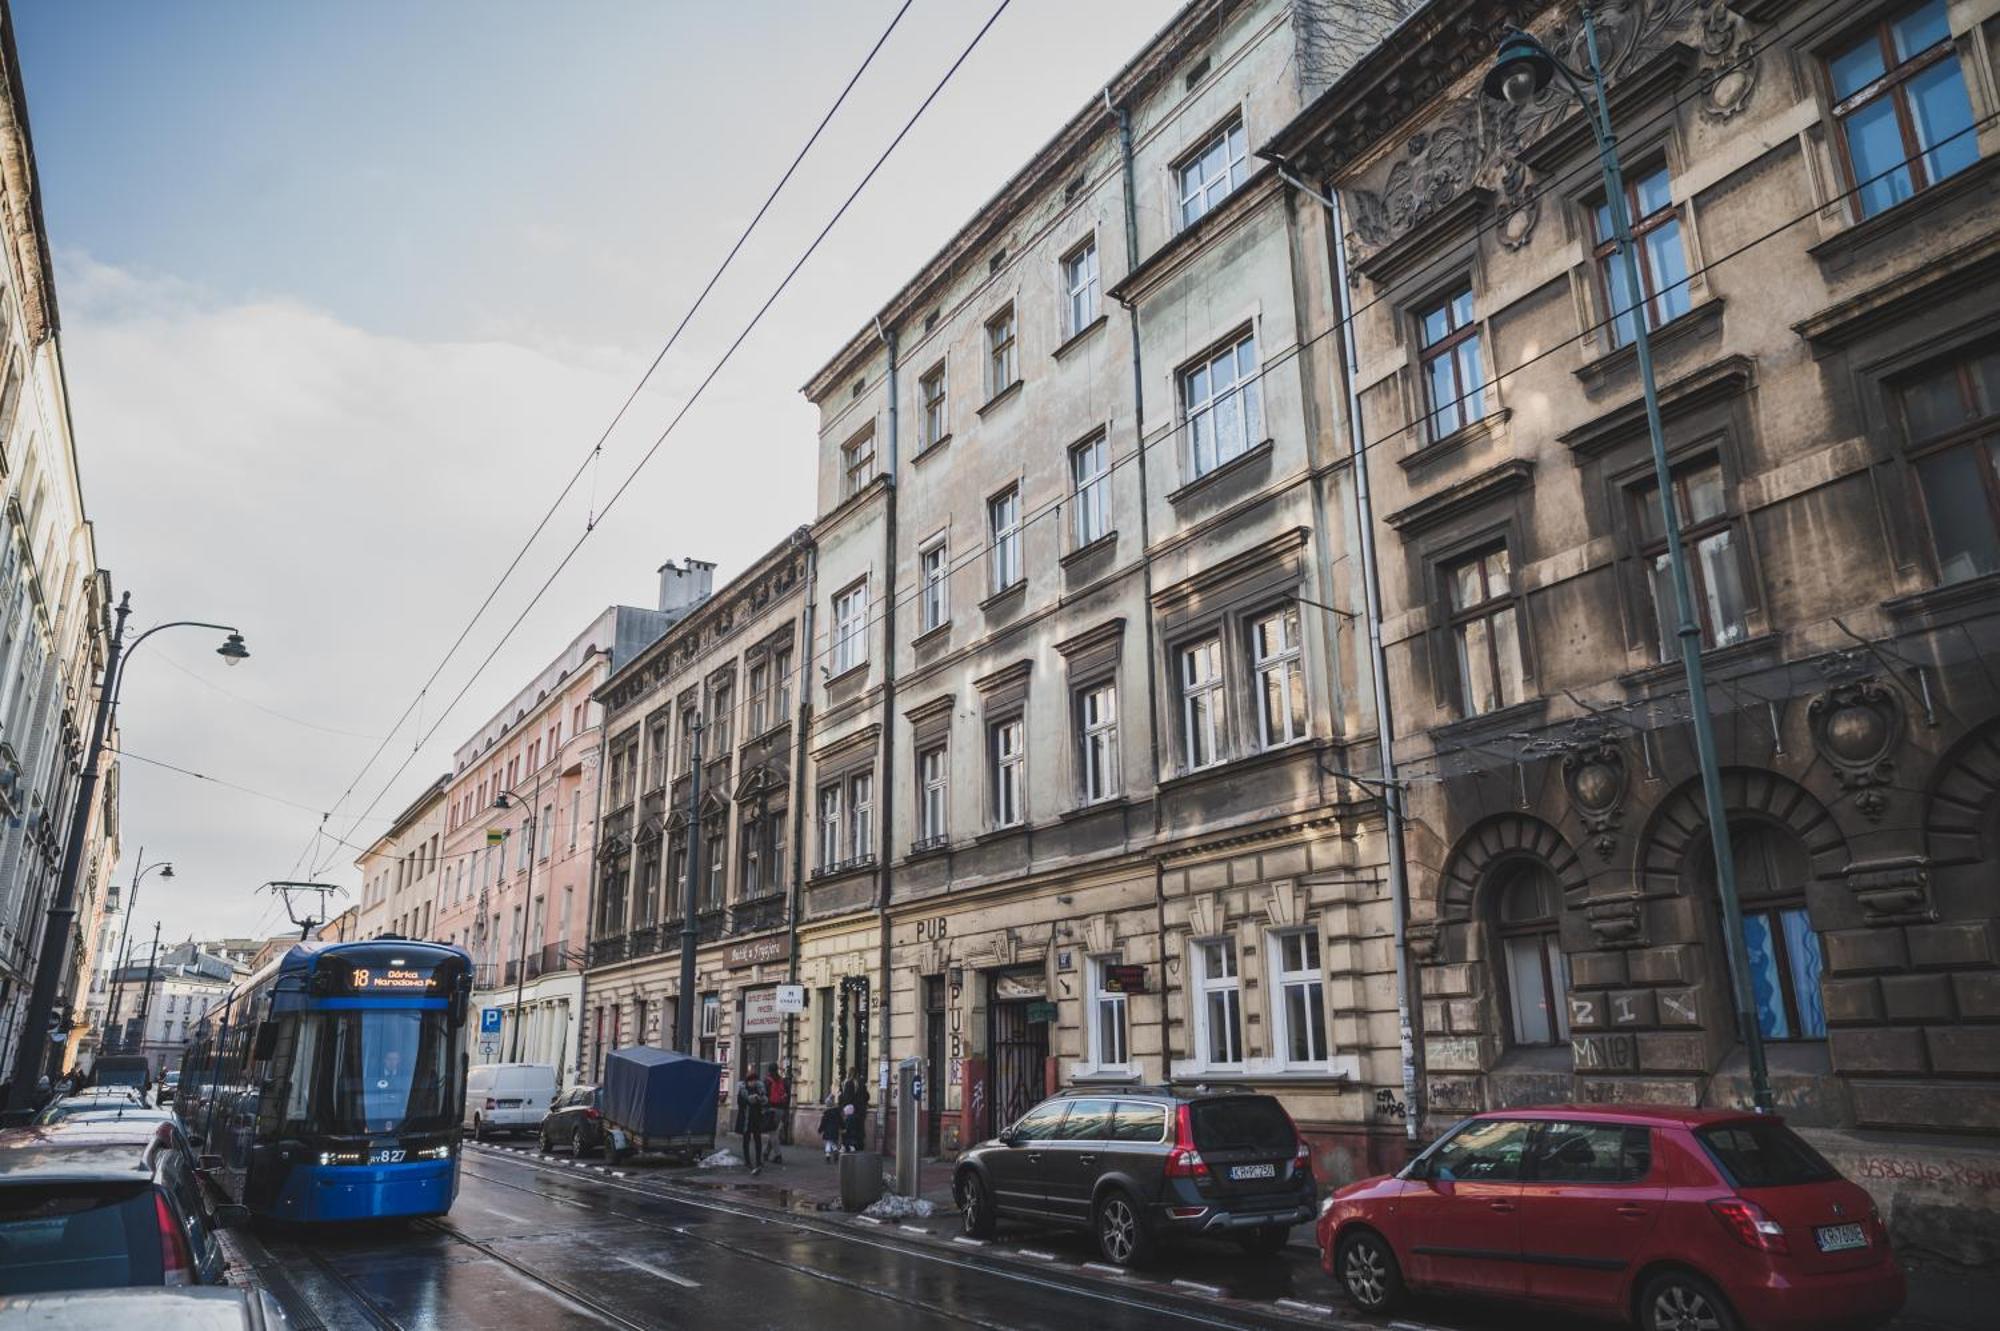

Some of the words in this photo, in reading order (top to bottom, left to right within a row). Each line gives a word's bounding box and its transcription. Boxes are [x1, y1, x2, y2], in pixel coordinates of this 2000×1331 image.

[917, 917, 947, 942] PUB
[353, 969, 369, 987] 18
[374, 979, 424, 987] Narodowa
[486, 1010, 498, 1026] P
[951, 986, 960, 1057] PUB
[913, 1081, 921, 1096] P
